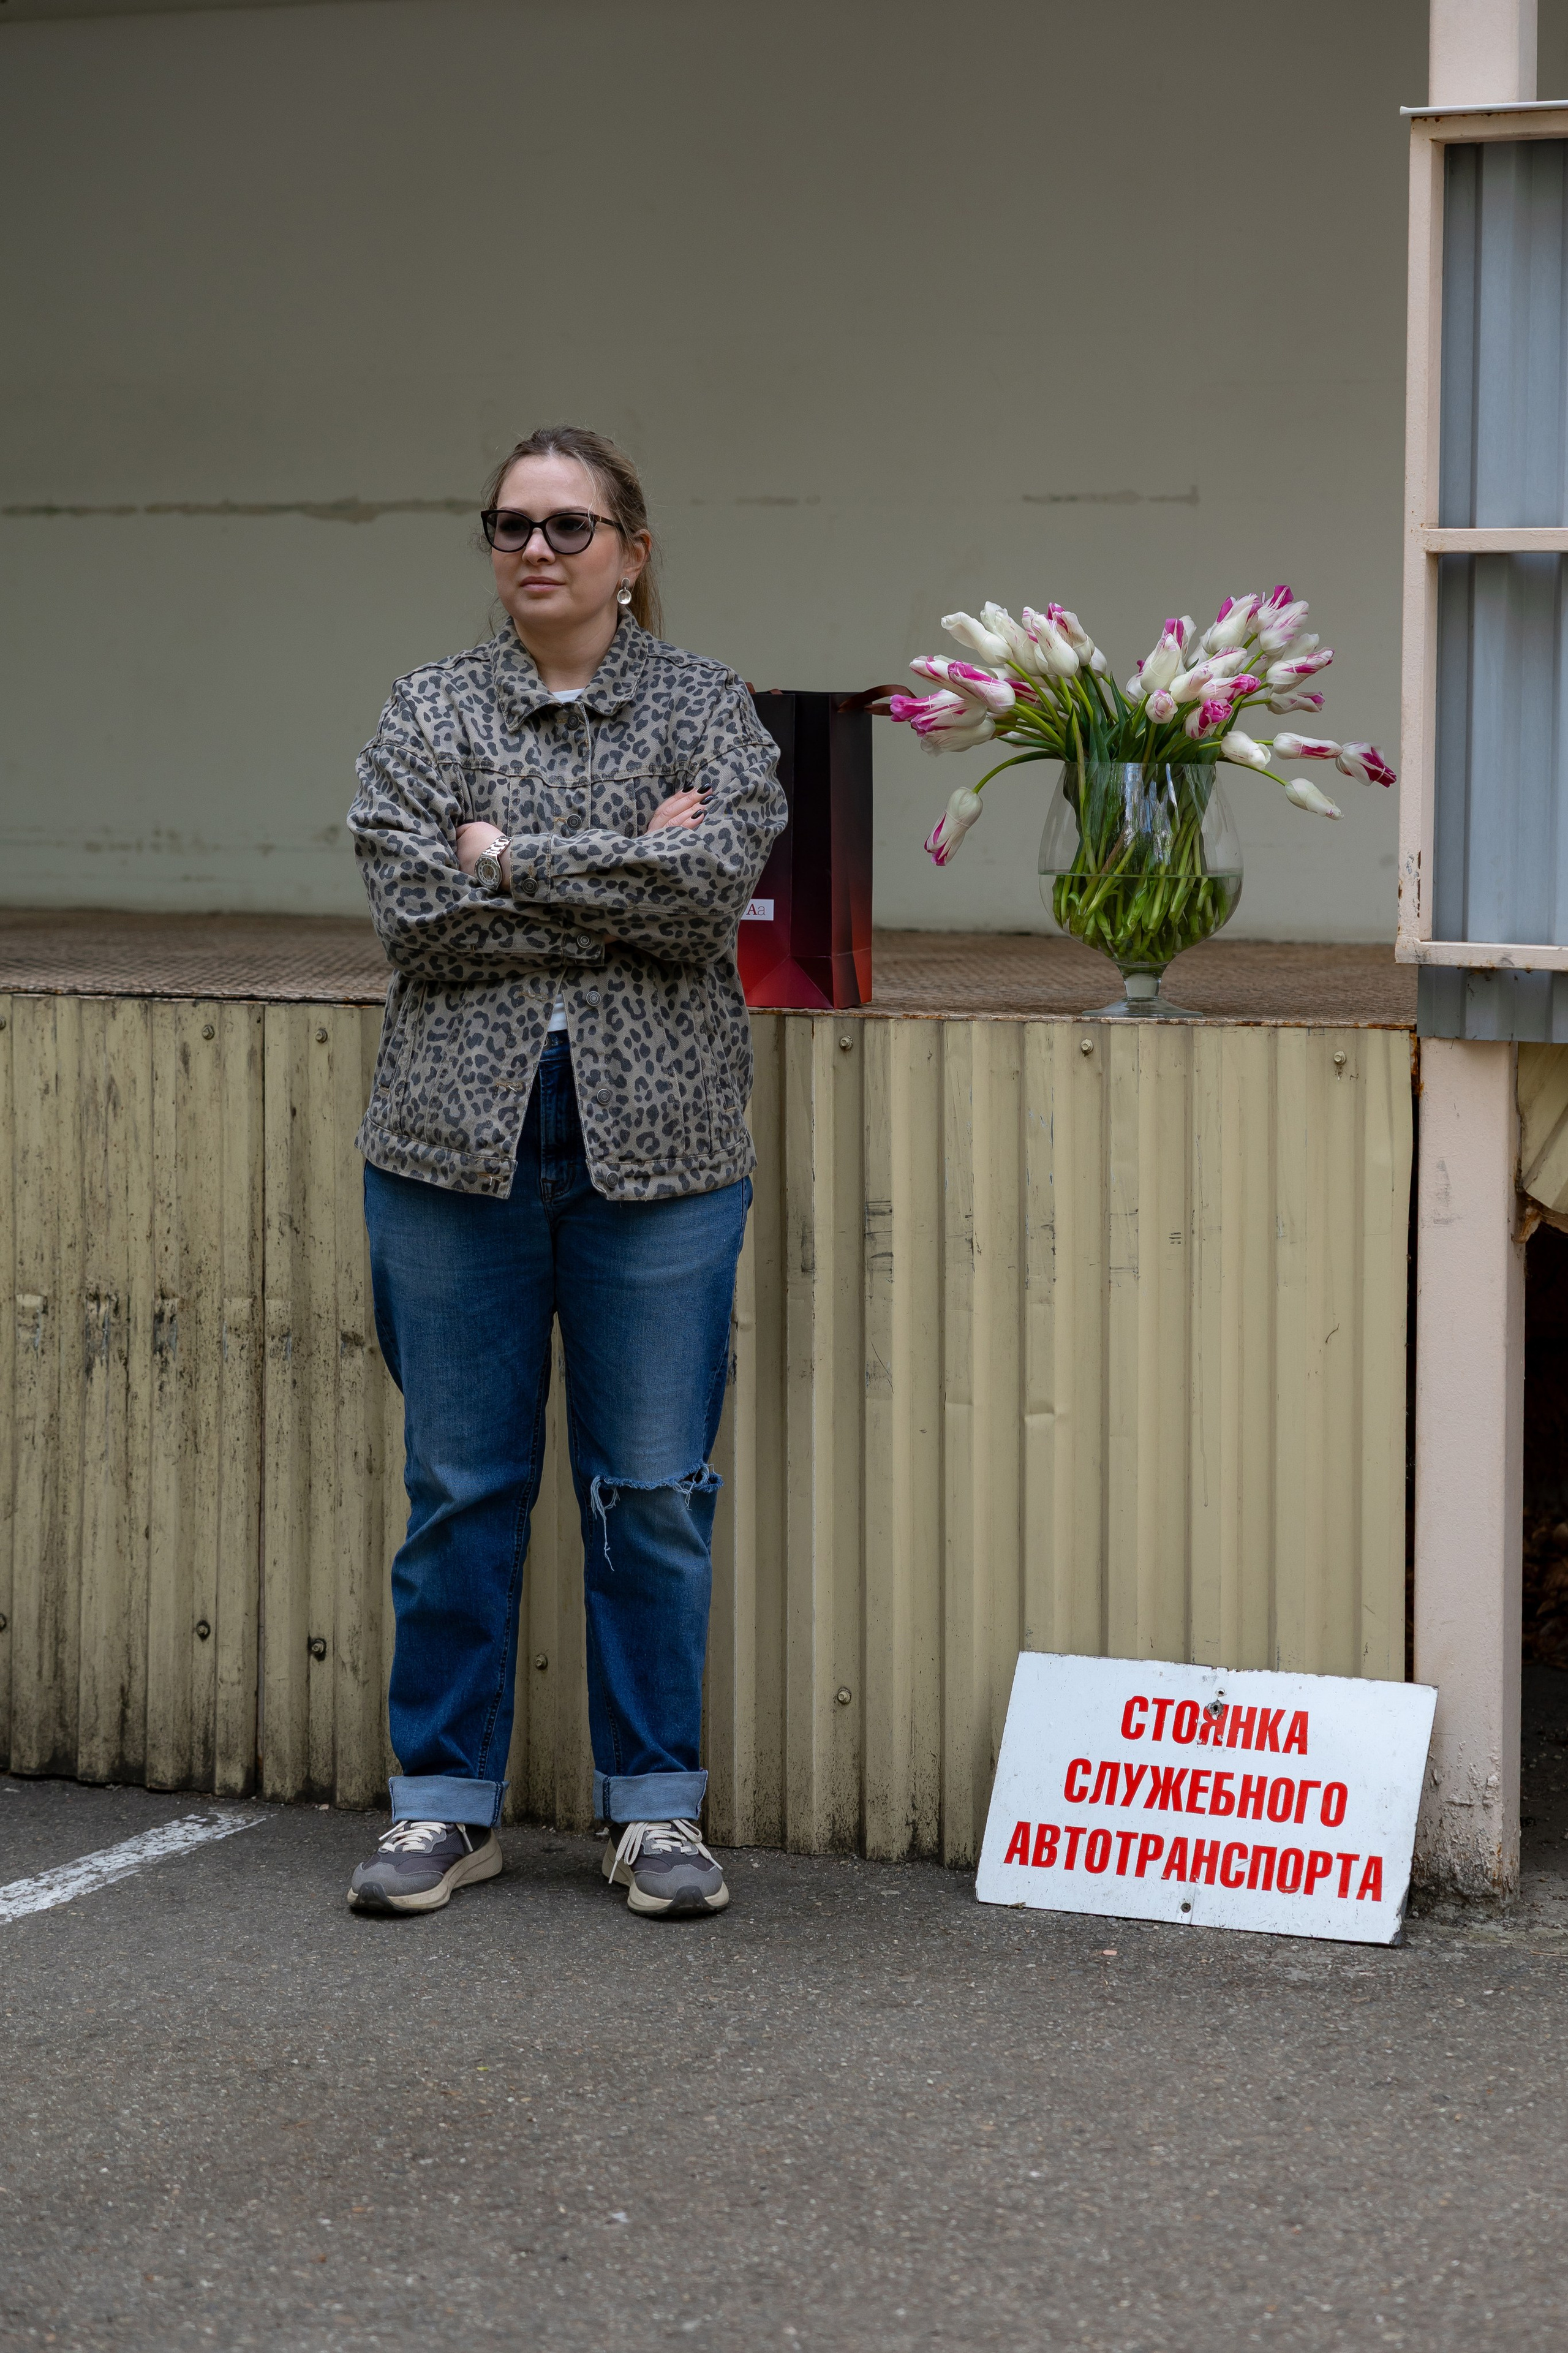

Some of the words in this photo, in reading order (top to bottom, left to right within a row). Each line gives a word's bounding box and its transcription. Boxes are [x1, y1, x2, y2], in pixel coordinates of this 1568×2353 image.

[1121, 1695, 1309, 1756] СТОЯНКА
[1063, 1758, 1348, 1828] СЛУЖЕБНОГО
[1003, 1821, 1383, 1902] АВТОТРАНСПОРТА
